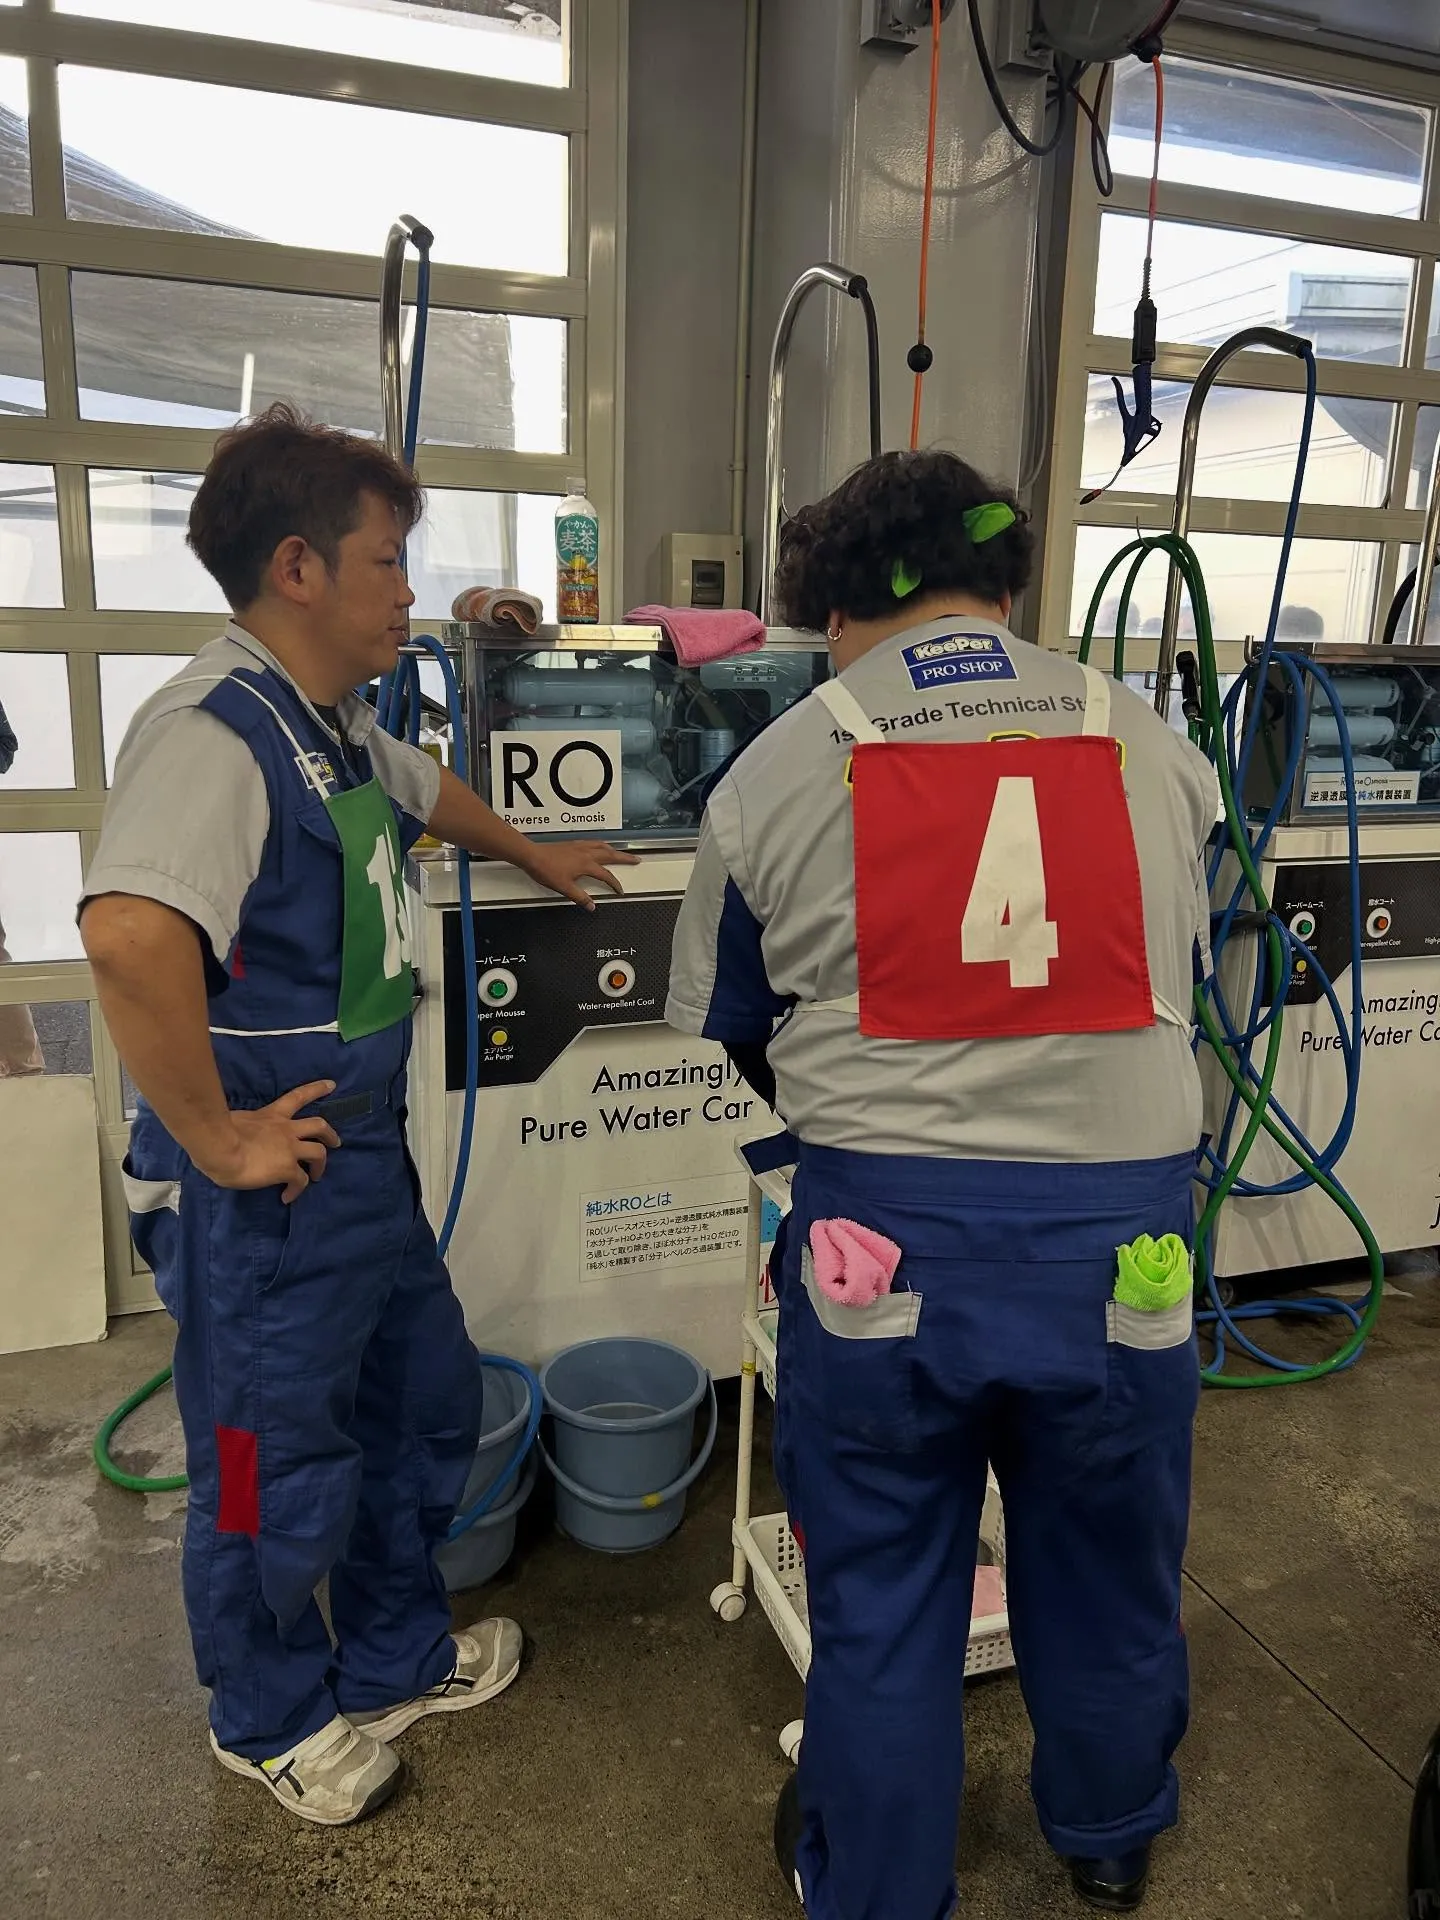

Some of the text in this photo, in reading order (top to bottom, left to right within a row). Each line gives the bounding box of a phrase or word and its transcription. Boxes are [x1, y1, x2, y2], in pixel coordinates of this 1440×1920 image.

[559, 530, 596, 552] 麦茶
[922, 660, 1003, 681] PRO SHOP
[829, 696, 1086, 744] 1s Grade Technical St
[502, 740, 614, 809] RO
[1310, 789, 1412, 803] 逆浸透膜純水精製装置
[504, 811, 606, 825] Reverse Osmosis
[961, 777, 1059, 988] 4
[495, 1009, 526, 1018] Mousse
[578, 1000, 635, 1011] Water-repellent
[1300, 1031, 1343, 1053] Pure
[483, 1054, 494, 1062] Air
[521, 1117, 588, 1145] Pure
[599, 1104, 692, 1136] Water
[702, 1095, 754, 1122] Car
[586, 1191, 673, 1217] 純水ROとは
